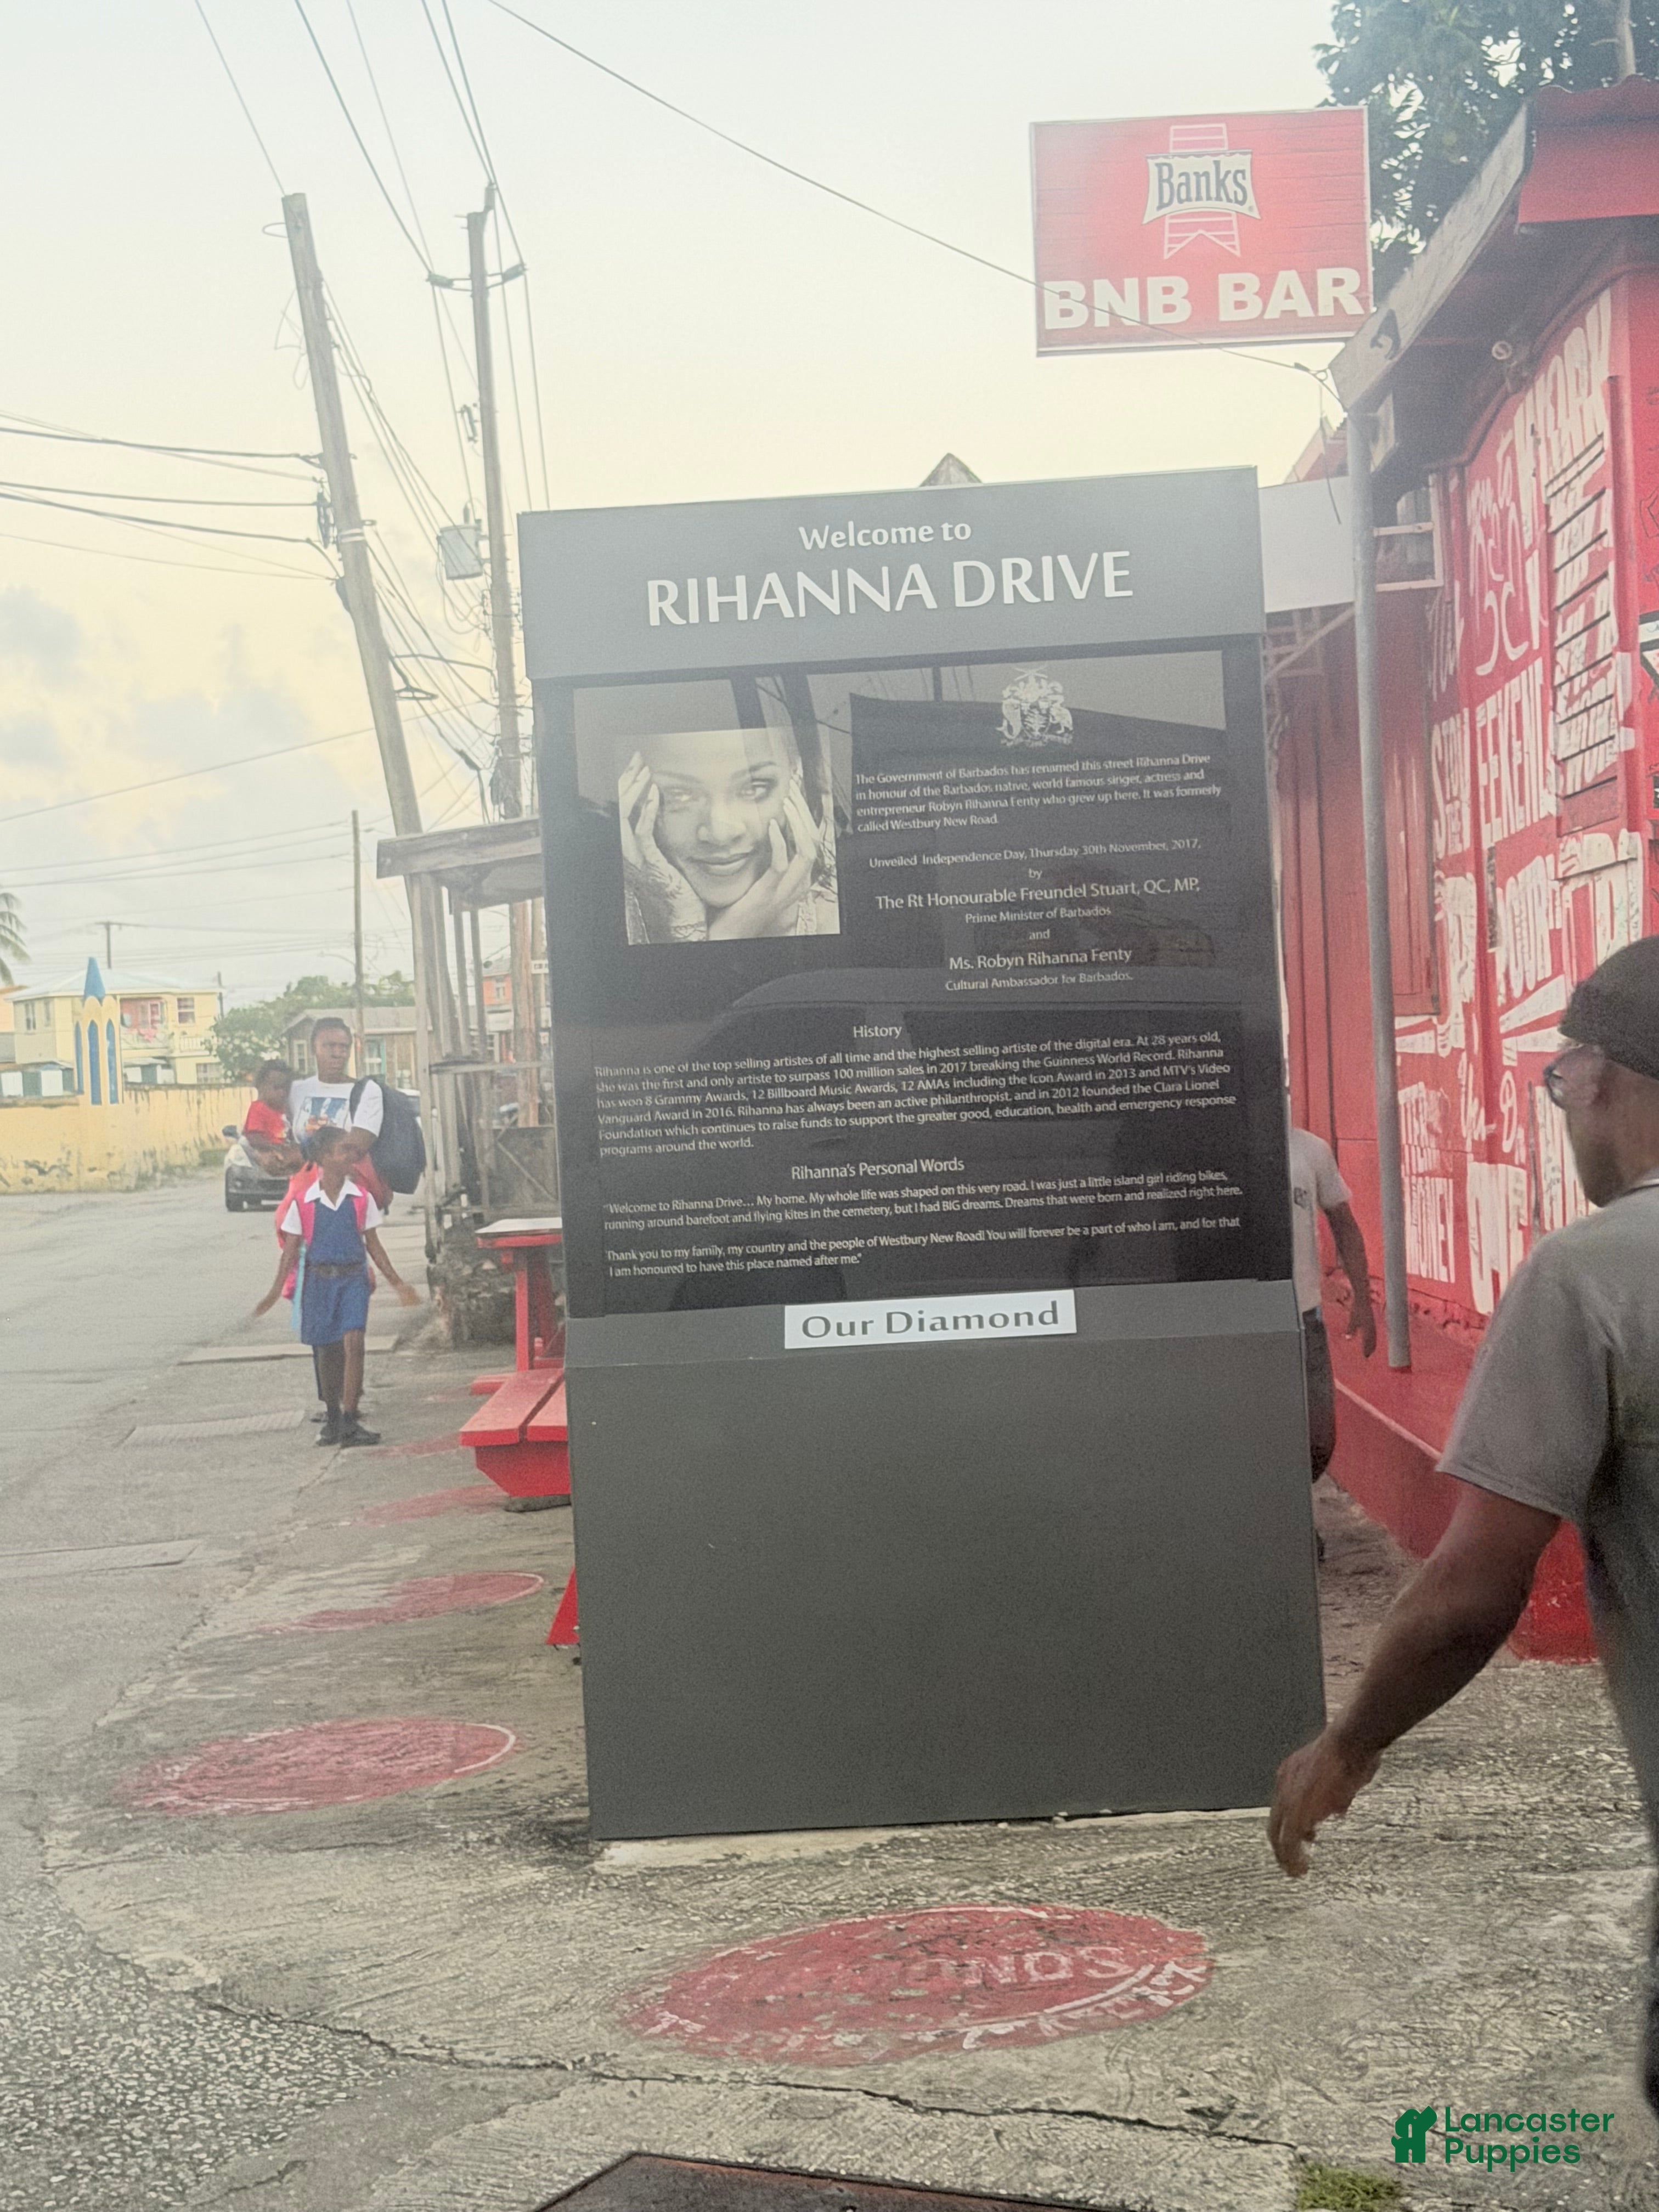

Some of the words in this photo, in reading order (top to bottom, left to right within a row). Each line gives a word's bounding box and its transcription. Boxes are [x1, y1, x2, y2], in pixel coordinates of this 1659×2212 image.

[1155, 160, 1248, 212] Banks
[1043, 276, 1192, 330] BNB
[1218, 267, 1364, 321] BAR
[798, 521, 934, 550] Welcome
[941, 522, 972, 541] to
[647, 563, 938, 627] RIHANNA
[953, 550, 1133, 608] DRIVE
[857, 821, 889, 832] called
[890, 819, 941, 830] Westbury
[943, 816, 968, 827] New
[868, 855, 918, 868] Unveiled
[921, 852, 1002, 866] Independence
[1030, 846, 1079, 858] Thursday
[1082, 844, 1107, 855] 30th
[1027, 868, 1042, 880] by
[877, 895, 904, 909] The
[906, 894, 923, 907] Rt
[927, 889, 1017, 906] Honourable
[1019, 884, 1087, 901] Freundel
[965, 913, 997, 923] Prime
[998, 910, 1043, 922] Minister
[1045, 908, 1057, 919] of
[1059, 906, 1111, 918] Barbados
[1028, 929, 1050, 940] and
[977, 954, 1024, 970] Robyn
[1027, 951, 1088, 966] Rihanna
[1090, 947, 1132, 963] Fenty
[945, 978, 989, 991] Cultural
[990, 975, 1058, 988] Ambassador
[1061, 974, 1076, 984] for
[852, 1024, 902, 1039] History
[653, 1065, 675, 1074] one
[677, 1062, 689, 1072] of
[691, 1061, 710, 1071] the
[712, 1060, 732, 1072] top
[733, 1058, 771, 1070] selling
[772, 1056, 814, 1066] artistes
[815, 1054, 827, 1064] of
[829, 1053, 843, 1064] all
[844, 1053, 871, 1063] time
[872, 1050, 895, 1061] and
[896, 1049, 916, 1060] the
[918, 1047, 960, 1060] highest
[962, 1045, 1000, 1057] selling
[1001, 1042, 1037, 1054] artiste
[1039, 1041, 1051, 1052] of
[1053, 1041, 1073, 1051] the
[1074, 1038, 1111, 1051] digital
[1136, 1036, 1149, 1046] At
[1150, 1035, 1166, 1045] 28
[1167, 1035, 1198, 1047] years
[617, 1098, 643, 1107] won
[654, 1095, 702, 1105] Grammy
[752, 1089, 765, 1099] 12
[766, 1086, 817, 1099] Billboard
[818, 1085, 851, 1096] Music
[901, 1081, 915, 1091] 12
[916, 1079, 950, 1090] AMAs
[952, 1076, 1006, 1088] including
[1007, 1075, 1027, 1085] the
[1029, 1074, 1054, 1084] Icon
[1055, 1070, 1093, 1082] Award
[1094, 1070, 1106, 1080] in
[1108, 1068, 1136, 1079] 2013
[1138, 1066, 1161, 1077] and
[1162, 1065, 1196, 1076] MTV's
[1197, 1063, 1231, 1074] Video
[653, 1109, 690, 1121] Award
[691, 1109, 703, 1119] in
[737, 1106, 783, 1116] Rihanna
[785, 1104, 805, 1114] has
[806, 1102, 845, 1113] always
[846, 1100, 876, 1110] been
[877, 1100, 892, 1108] an
[894, 1097, 928, 1108] active
[1013, 1090, 1036, 1101] and
[1037, 1090, 1049, 1099] in
[1052, 1087, 1080, 1098] 2012
[1081, 1084, 1130, 1097] founded
[1132, 1084, 1152, 1094] the
[1153, 1082, 1183, 1093] Clara
[1184, 1079, 1220, 1091] Lionel
[664, 1125, 698, 1136] which
[700, 1123, 756, 1134] continues
[757, 1121, 770, 1131] to
[772, 1120, 798, 1130] raise
[799, 1118, 832, 1128] funds
[834, 1116, 847, 1126] to
[848, 1114, 894, 1127] support
[895, 1113, 915, 1123] the
[916, 1110, 957, 1124] greater
[1056, 1102, 1093, 1114] health
[1094, 1101, 1117, 1112] and
[1119, 1099, 1183, 1111] emergency
[1184, 1096, 1237, 1108] response
[600, 1146, 653, 1158] programs
[654, 1141, 696, 1153] around
[697, 1140, 716, 1150] the
[791, 1164, 856, 1180] Rihanna's
[858, 1160, 918, 1176] Personal
[920, 1158, 964, 1172] Words
[614, 1268, 631, 1277] am
[632, 1263, 684, 1276] honoured
[685, 1262, 697, 1272] to
[698, 1262, 724, 1272] have
[725, 1260, 744, 1271] this
[746, 1259, 775, 1272] place
[775, 1256, 812, 1268] named
[814, 1255, 838, 1266] after
[802, 1316, 874, 1338] Our
[886, 1300, 1059, 1334] Diamond
